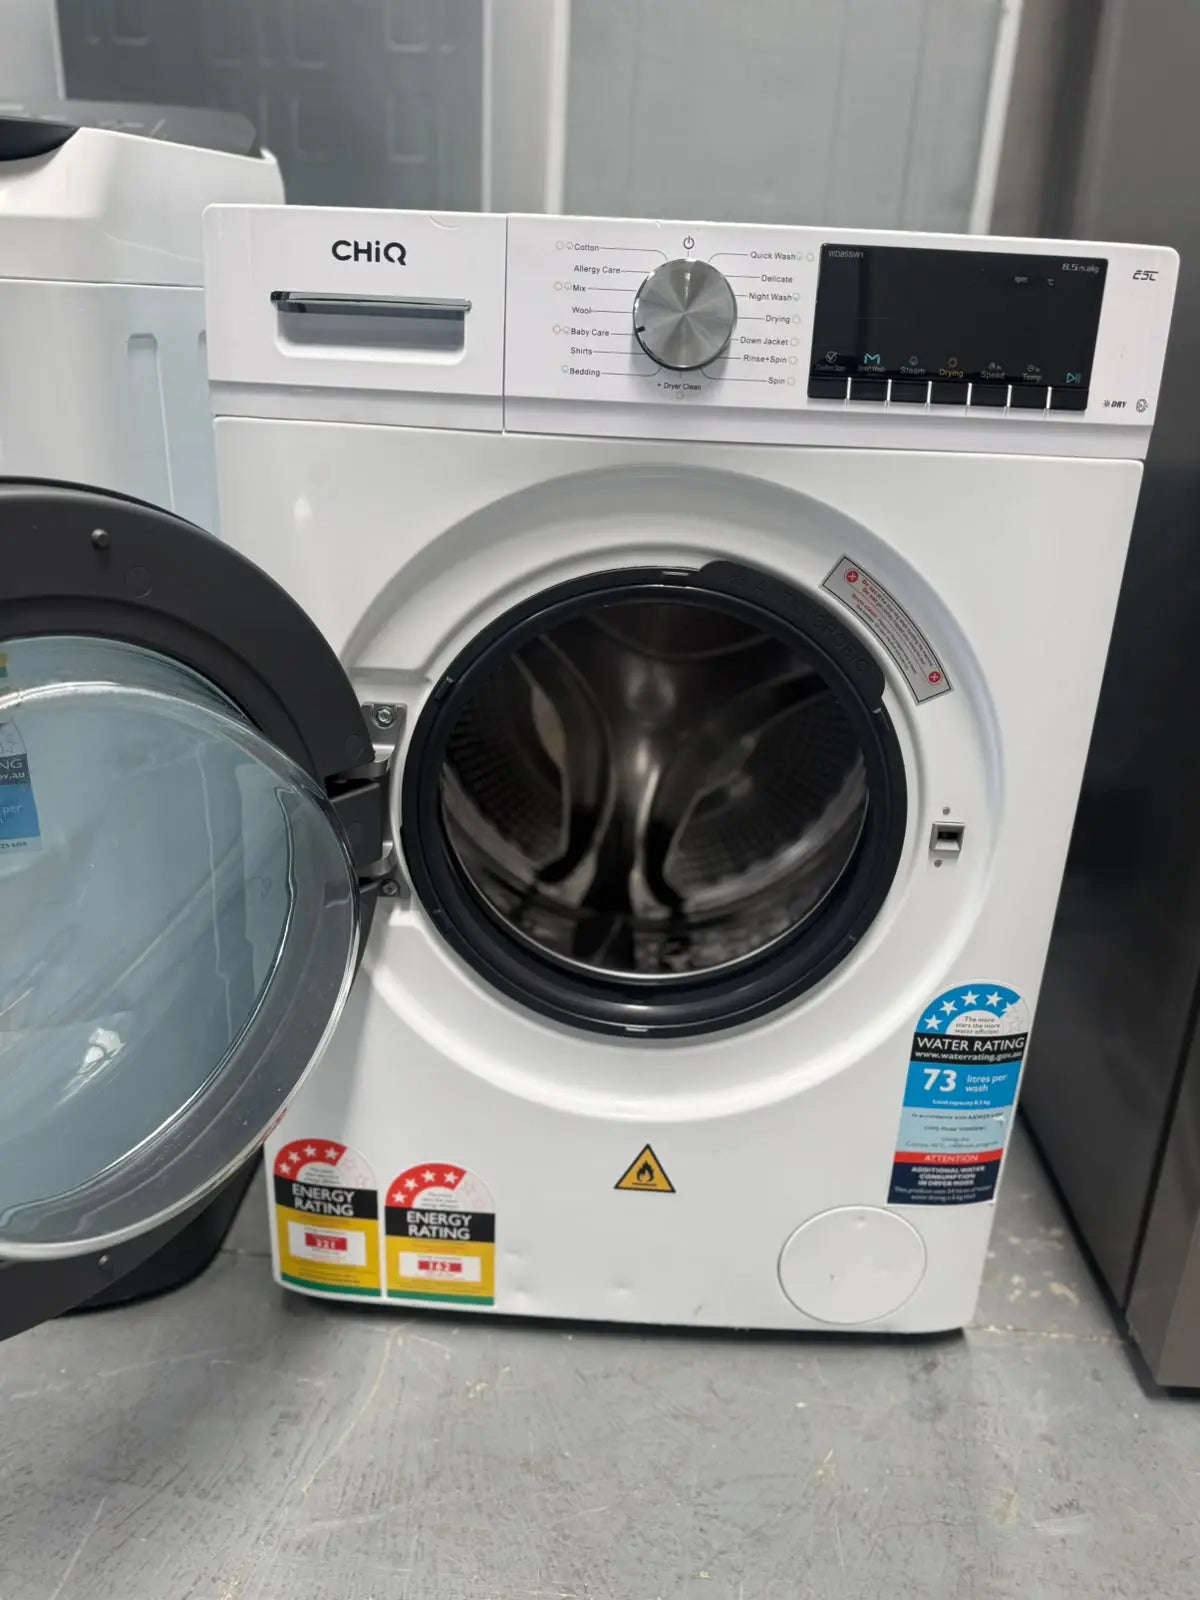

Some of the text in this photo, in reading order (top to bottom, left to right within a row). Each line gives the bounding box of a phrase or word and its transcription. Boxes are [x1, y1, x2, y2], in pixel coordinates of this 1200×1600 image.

[574, 243, 600, 251] Cotton
[331, 239, 407, 266] CHiQ
[750, 252, 772, 260] Quick
[574, 265, 621, 274] Allergy Care
[761, 275, 793, 283] Delicate
[748, 293, 769, 301] Night
[765, 315, 790, 324] Drying
[571, 328, 589, 337] Baby
[740, 336, 789, 346] Down Jacket
[570, 347, 593, 355] Shirts
[569, 368, 600, 377] Bedding
[900, 366, 926, 375] Steam
[939, 368, 964, 378] Drying
[981, 370, 1005, 380] Speed
[767, 377, 785, 386] Spin
[1022, 372, 1042, 382] Temp
[1110, 400, 1128, 409] DRY
[917, 1037, 1025, 1052] WATER RATING
[914, 1050, 1023, 1062] www.waterrating.gov.au
[922, 1067, 958, 1092] 73
[966, 1073, 1009, 1084] litres per
[964, 1083, 988, 1093] wash
[924, 1154, 979, 1163] ATTENTION
[291, 1183, 356, 1203] ENERGY
[293, 1196, 355, 1217] RATING
[406, 1211, 473, 1227] ENERGY
[408, 1224, 471, 1240] RATING
